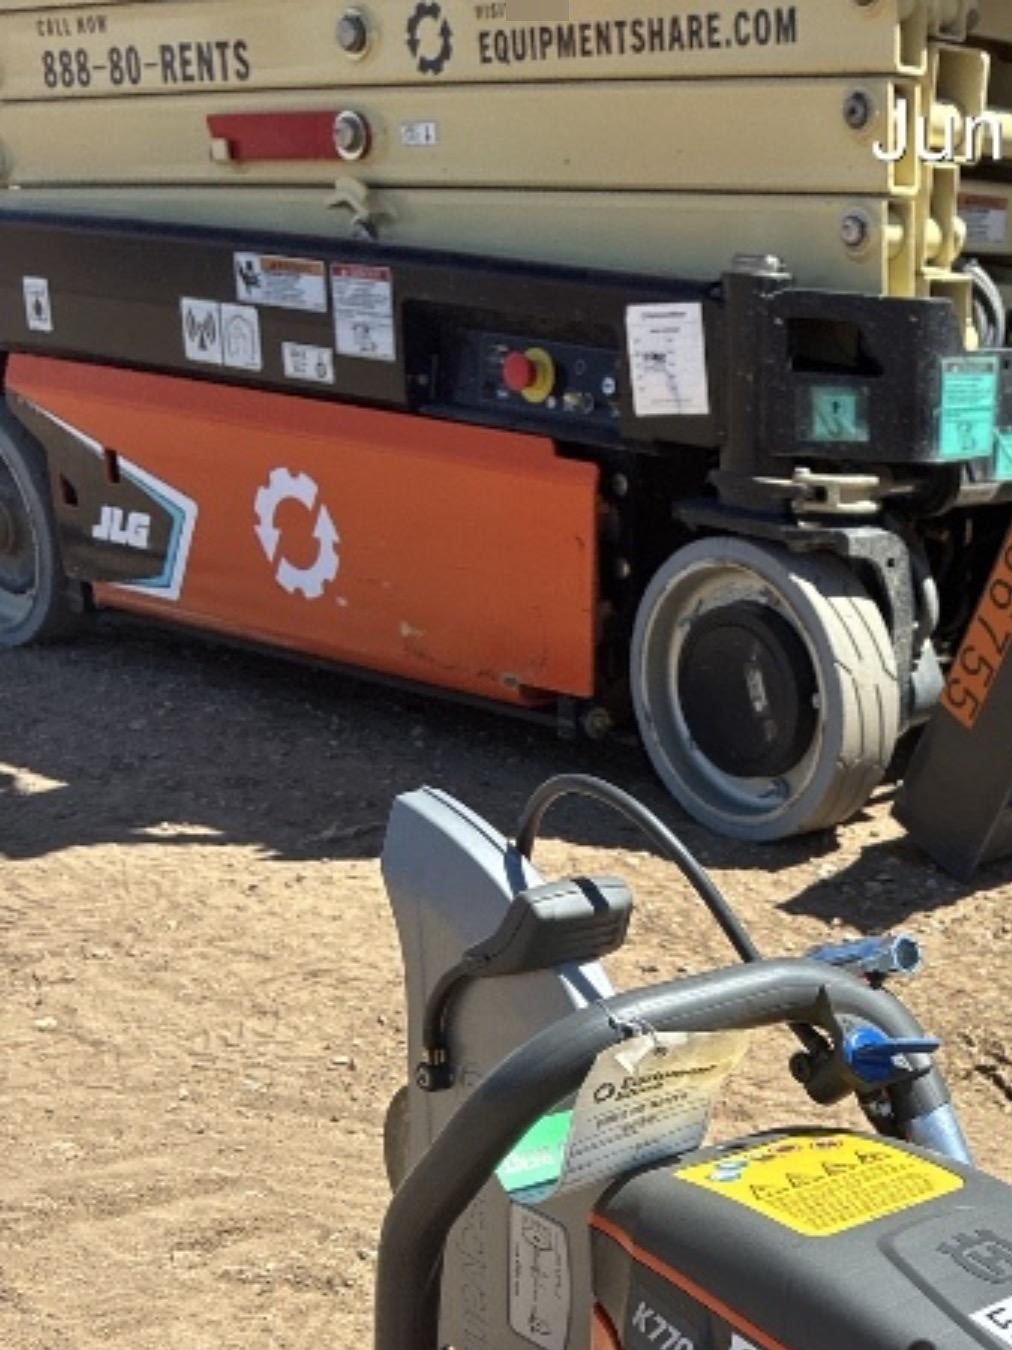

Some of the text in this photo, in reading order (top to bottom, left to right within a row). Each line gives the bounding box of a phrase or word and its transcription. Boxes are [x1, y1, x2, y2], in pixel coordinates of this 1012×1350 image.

[477, 6, 798, 65] EQUIPMENTSHARE.COM
[42, 39, 251, 89] 888-80-RENTS
[92, 505, 150, 549] JLG
